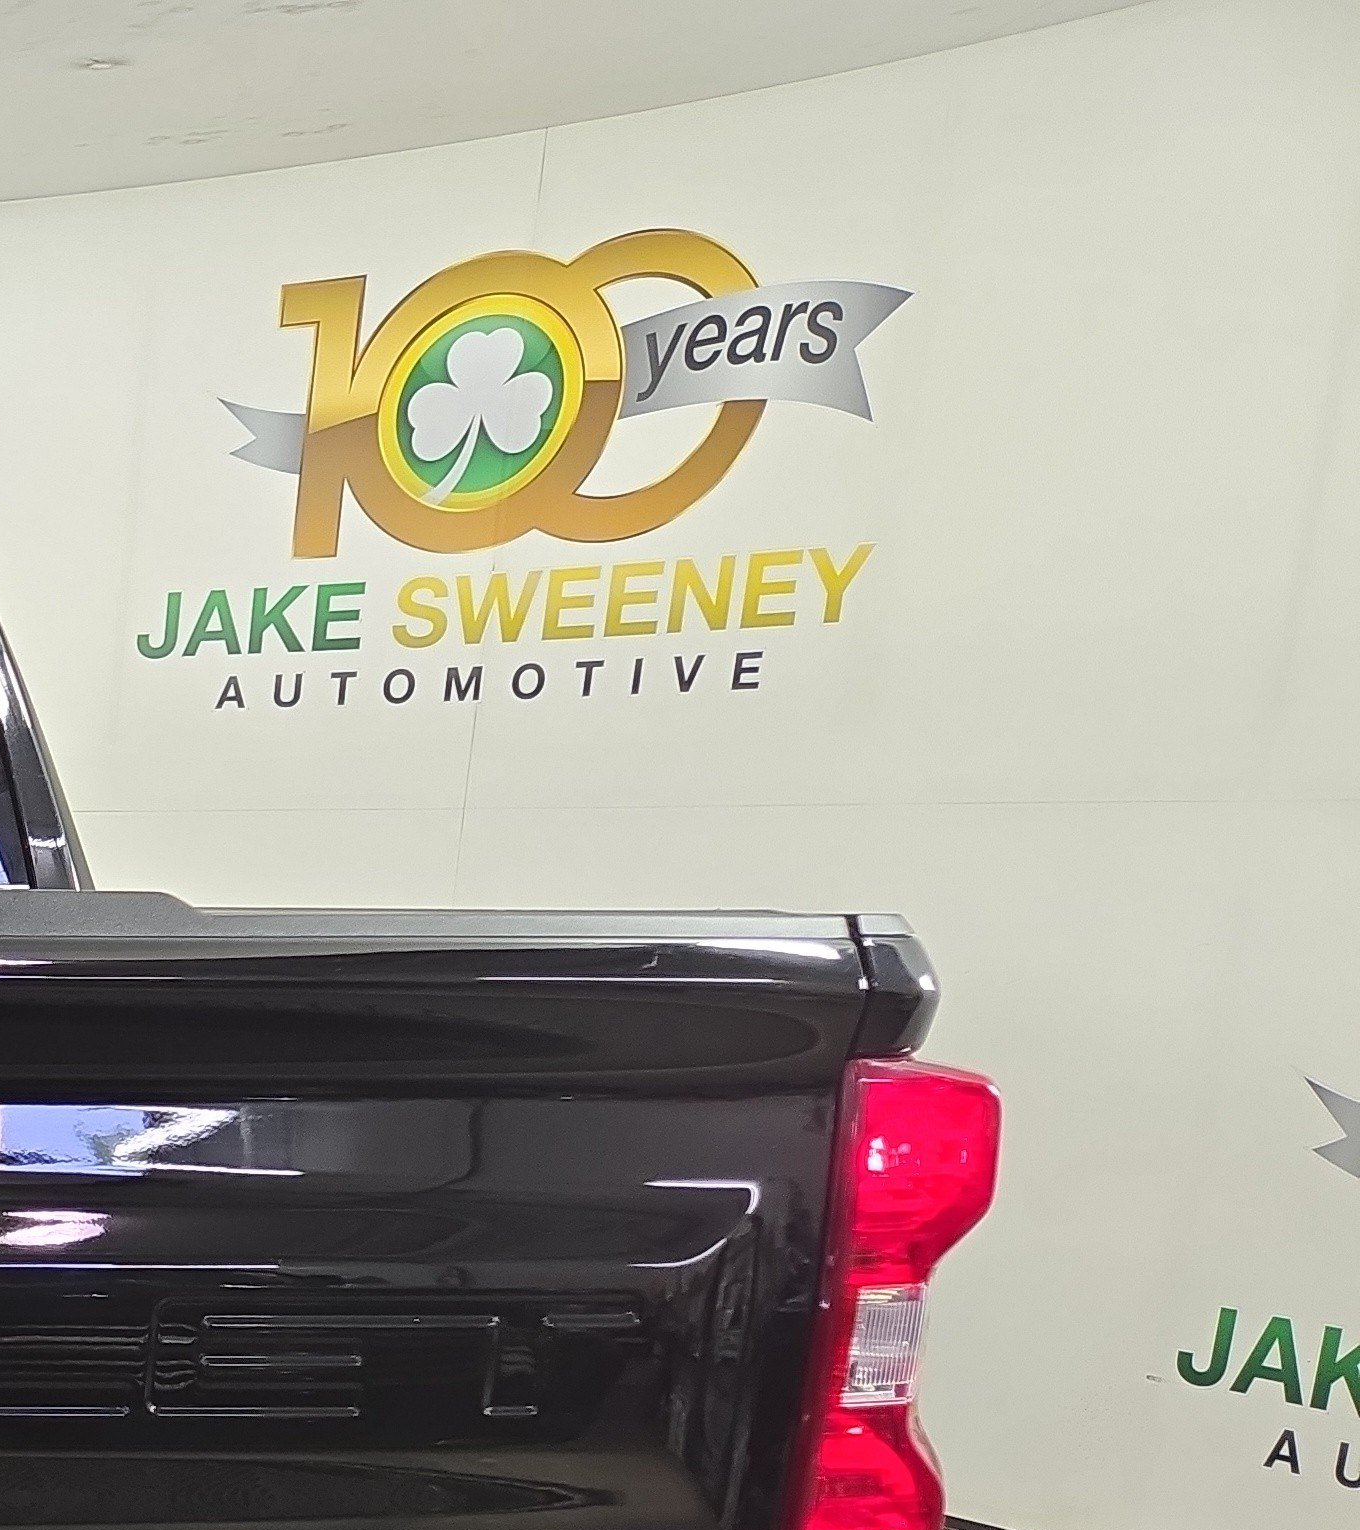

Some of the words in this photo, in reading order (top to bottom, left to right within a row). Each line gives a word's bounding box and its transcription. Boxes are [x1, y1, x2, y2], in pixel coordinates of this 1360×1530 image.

[636, 296, 845, 403] years
[136, 581, 368, 660] JAKE
[391, 542, 877, 649] SWEENEY
[214, 651, 765, 710] AUTOMOTIVE
